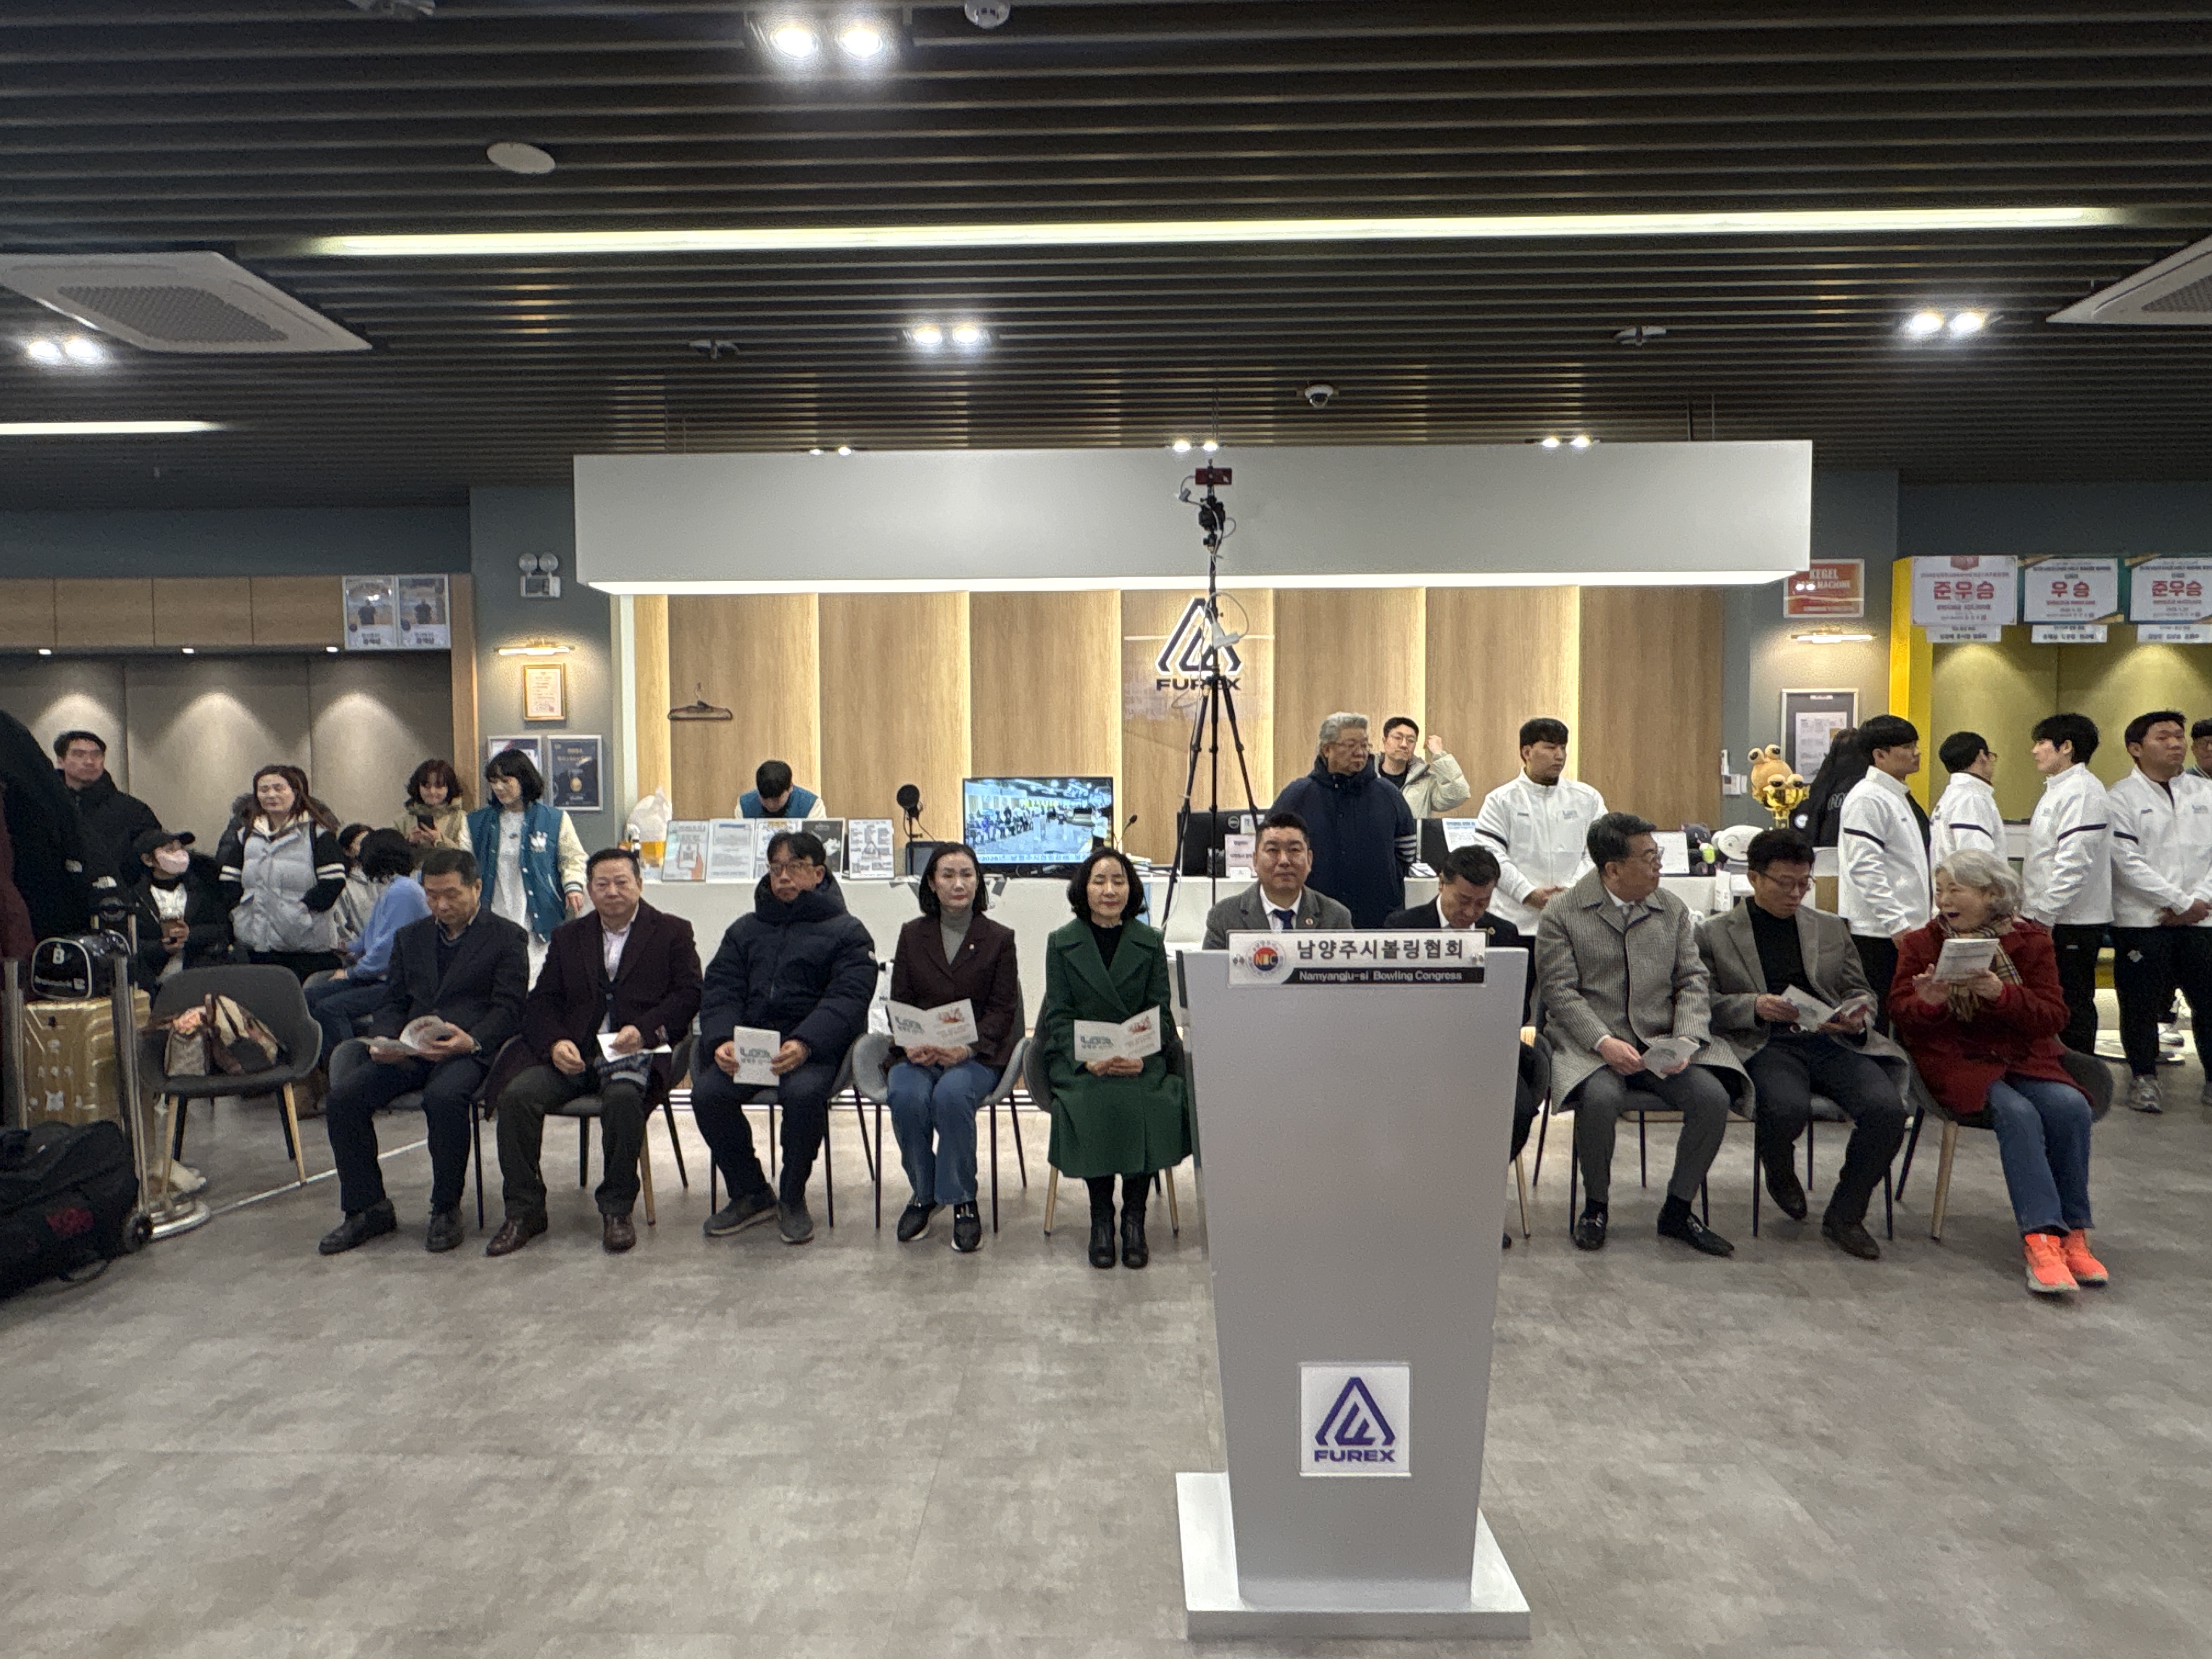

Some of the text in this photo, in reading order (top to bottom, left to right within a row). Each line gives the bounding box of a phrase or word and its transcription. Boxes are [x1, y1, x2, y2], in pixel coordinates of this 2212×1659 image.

[1933, 580, 1995, 600] 준우승
[2152, 580, 2203, 597] 준우승
[1156, 678, 1242, 691] FURX
[1297, 939, 1463, 960] 남양주시볼링협회
[1373, 970, 1414, 981] Bowling
[1415, 970, 1463, 981] Congress
[1314, 1449, 1396, 1463] FUREX
